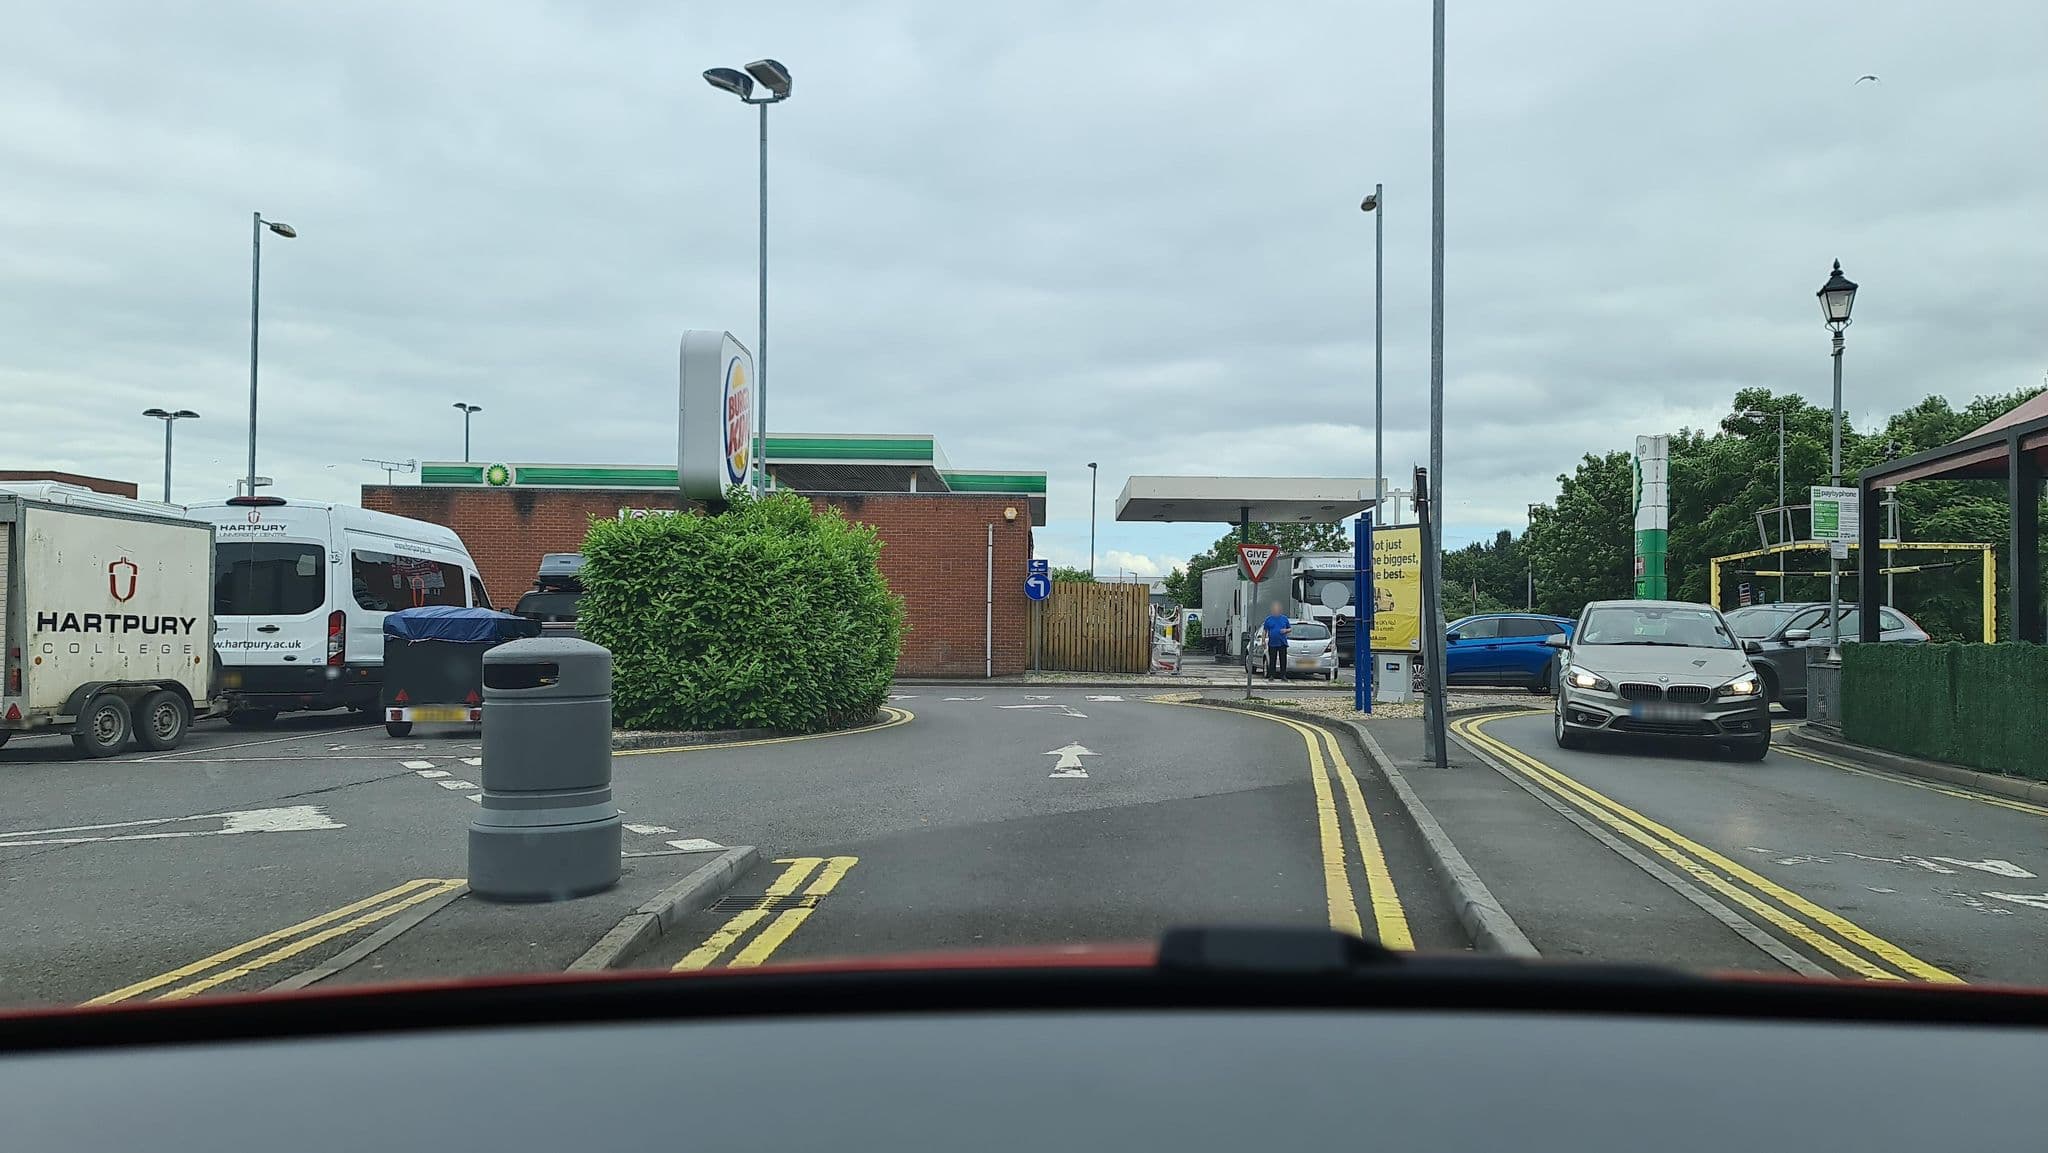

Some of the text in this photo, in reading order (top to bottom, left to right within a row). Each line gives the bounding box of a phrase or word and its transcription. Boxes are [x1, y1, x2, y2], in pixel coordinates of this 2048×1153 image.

[1375, 539, 1402, 552] ot just
[1246, 550, 1268, 558] GIVE
[1383, 553, 1419, 566] biggest,
[1383, 569, 1405, 579] best.
[36, 611, 197, 635] HARTPURY
[42, 642, 193, 654] COLLEGE
[213, 639, 302, 651] w.hartpury.ac.uk
